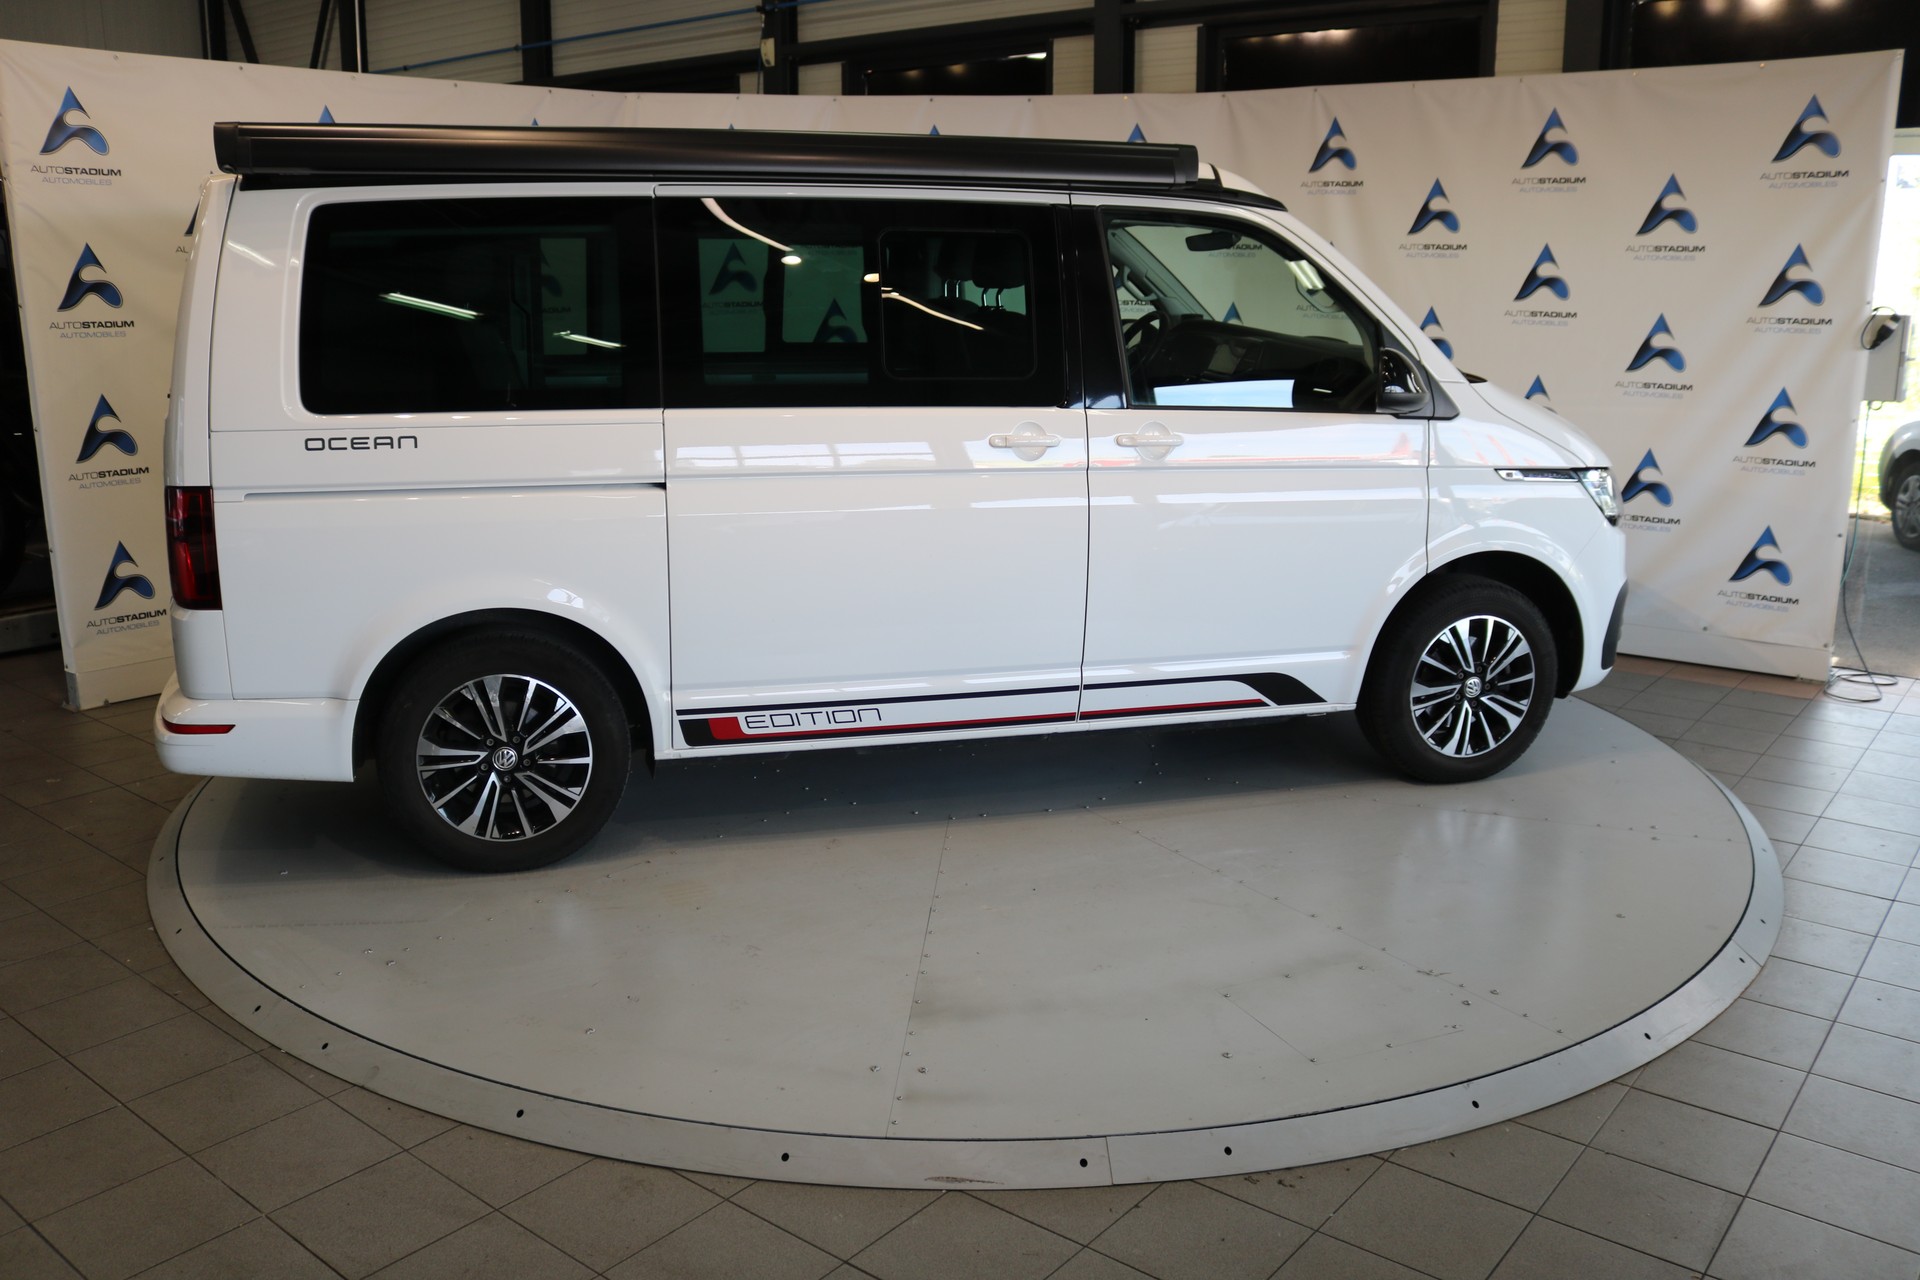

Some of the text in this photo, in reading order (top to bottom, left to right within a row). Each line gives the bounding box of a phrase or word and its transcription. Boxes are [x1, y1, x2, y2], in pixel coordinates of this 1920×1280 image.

[31, 164, 122, 176] AUTOSTADIUM
[1759, 169, 1850, 181] AUTOSTADIUM
[41, 176, 112, 186] AUTOMOBILES
[1300, 180, 1364, 188] AUTOSTADIUM
[1511, 176, 1587, 185] AUTOSTADIUM
[1768, 180, 1839, 189] AUTOMOBILES
[1399, 243, 1468, 252] AUTOSTADIUM
[1624, 244, 1706, 253] AUTOSTADIUM
[1503, 309, 1578, 319] AUTOSTADIUM
[50, 320, 135, 329] AUTOSTADIUM
[1745, 316, 1833, 326] AUTOSTADIUM
[59, 331, 127, 339] AUTOMOBILES
[1615, 381, 1693, 391] AUTOSTADIUM
[304, 435, 418, 452] OCEAN
[1732, 455, 1816, 468] AUTOSTADIUM
[68, 466, 150, 482] AUTOSTADIUM
[78, 476, 142, 490] AUTOMOBILES
[1717, 589, 1799, 605] AUTOSTADIUM
[86, 608, 167, 629] AUTOSTADIUM
[96, 619, 160, 636] AUTOMOBILES
[744, 707, 882, 729] EDITION
